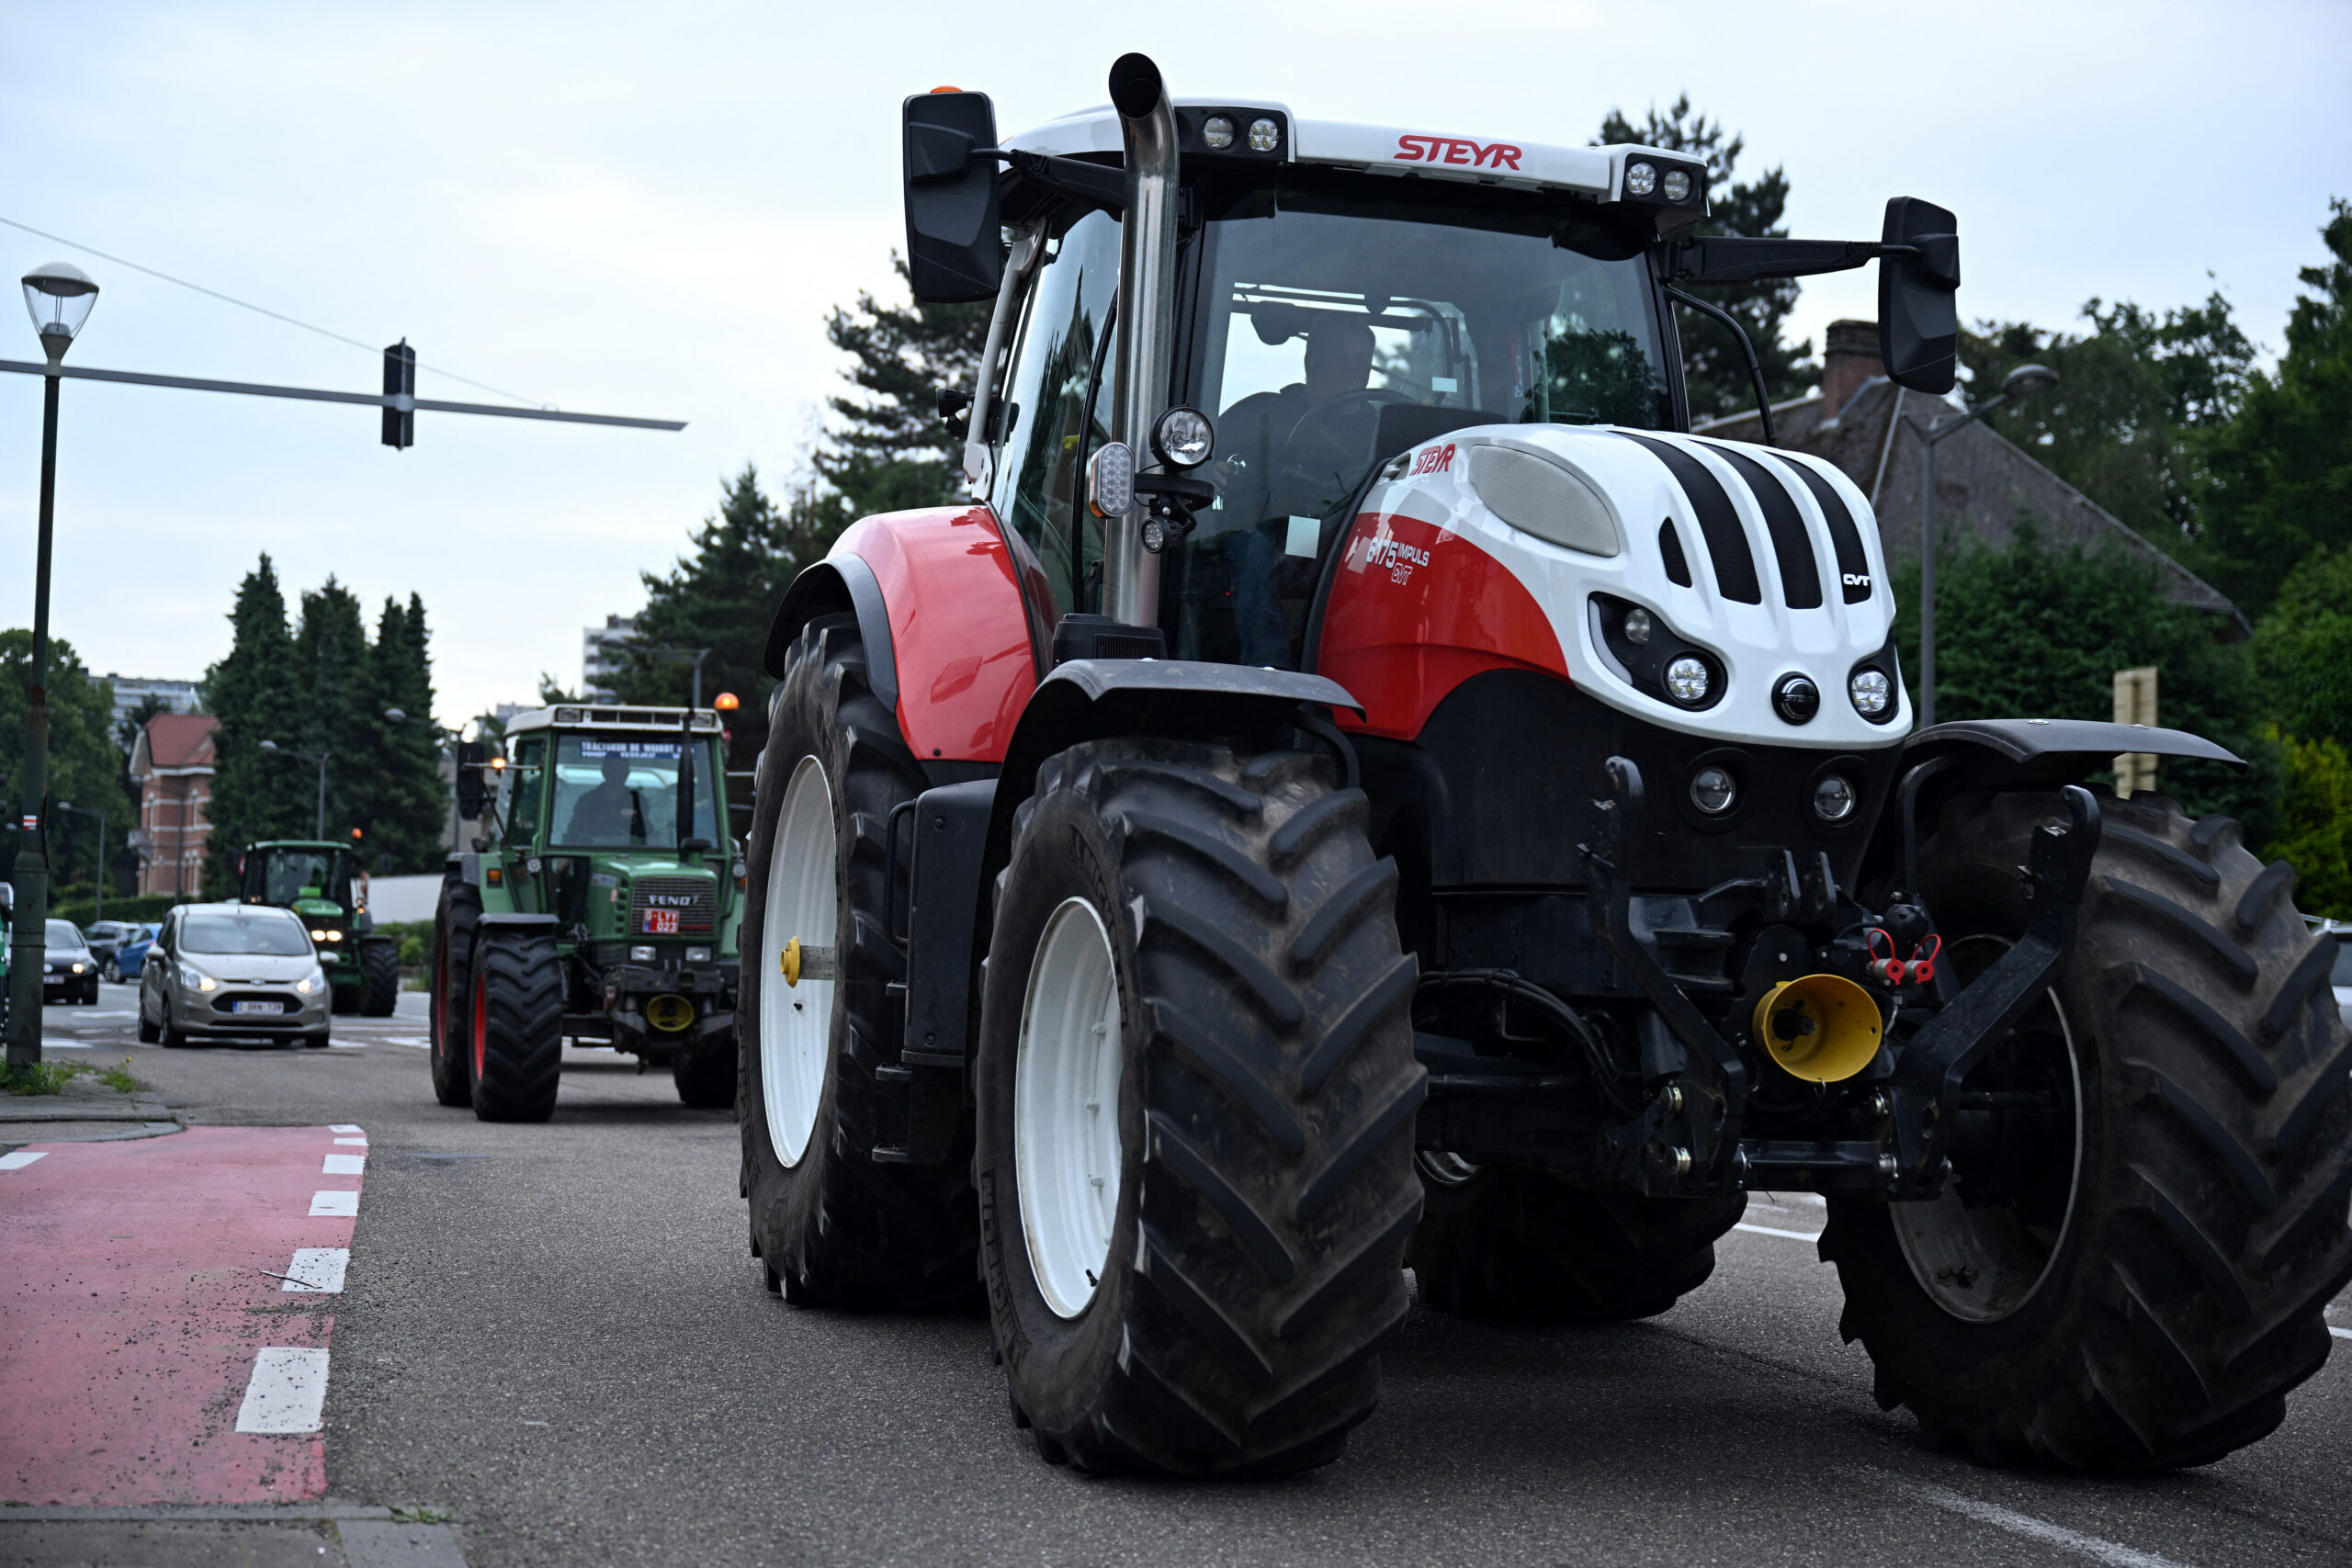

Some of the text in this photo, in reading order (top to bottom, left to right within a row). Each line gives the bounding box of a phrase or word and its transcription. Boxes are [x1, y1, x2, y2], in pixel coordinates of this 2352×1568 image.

[1394, 134, 1522, 171] STEYR
[1409, 444, 1456, 476] STEYR
[1366, 536, 1430, 570] 6175 IMPULS
[1391, 563, 1413, 586] CVT
[1843, 573, 1871, 587] CVT
[582, 742, 627, 752] TRACTOREN
[629, 742, 639, 752] DE
[649, 895, 700, 906] FENDT
[980, 1172, 1019, 1350] MICHELIN
